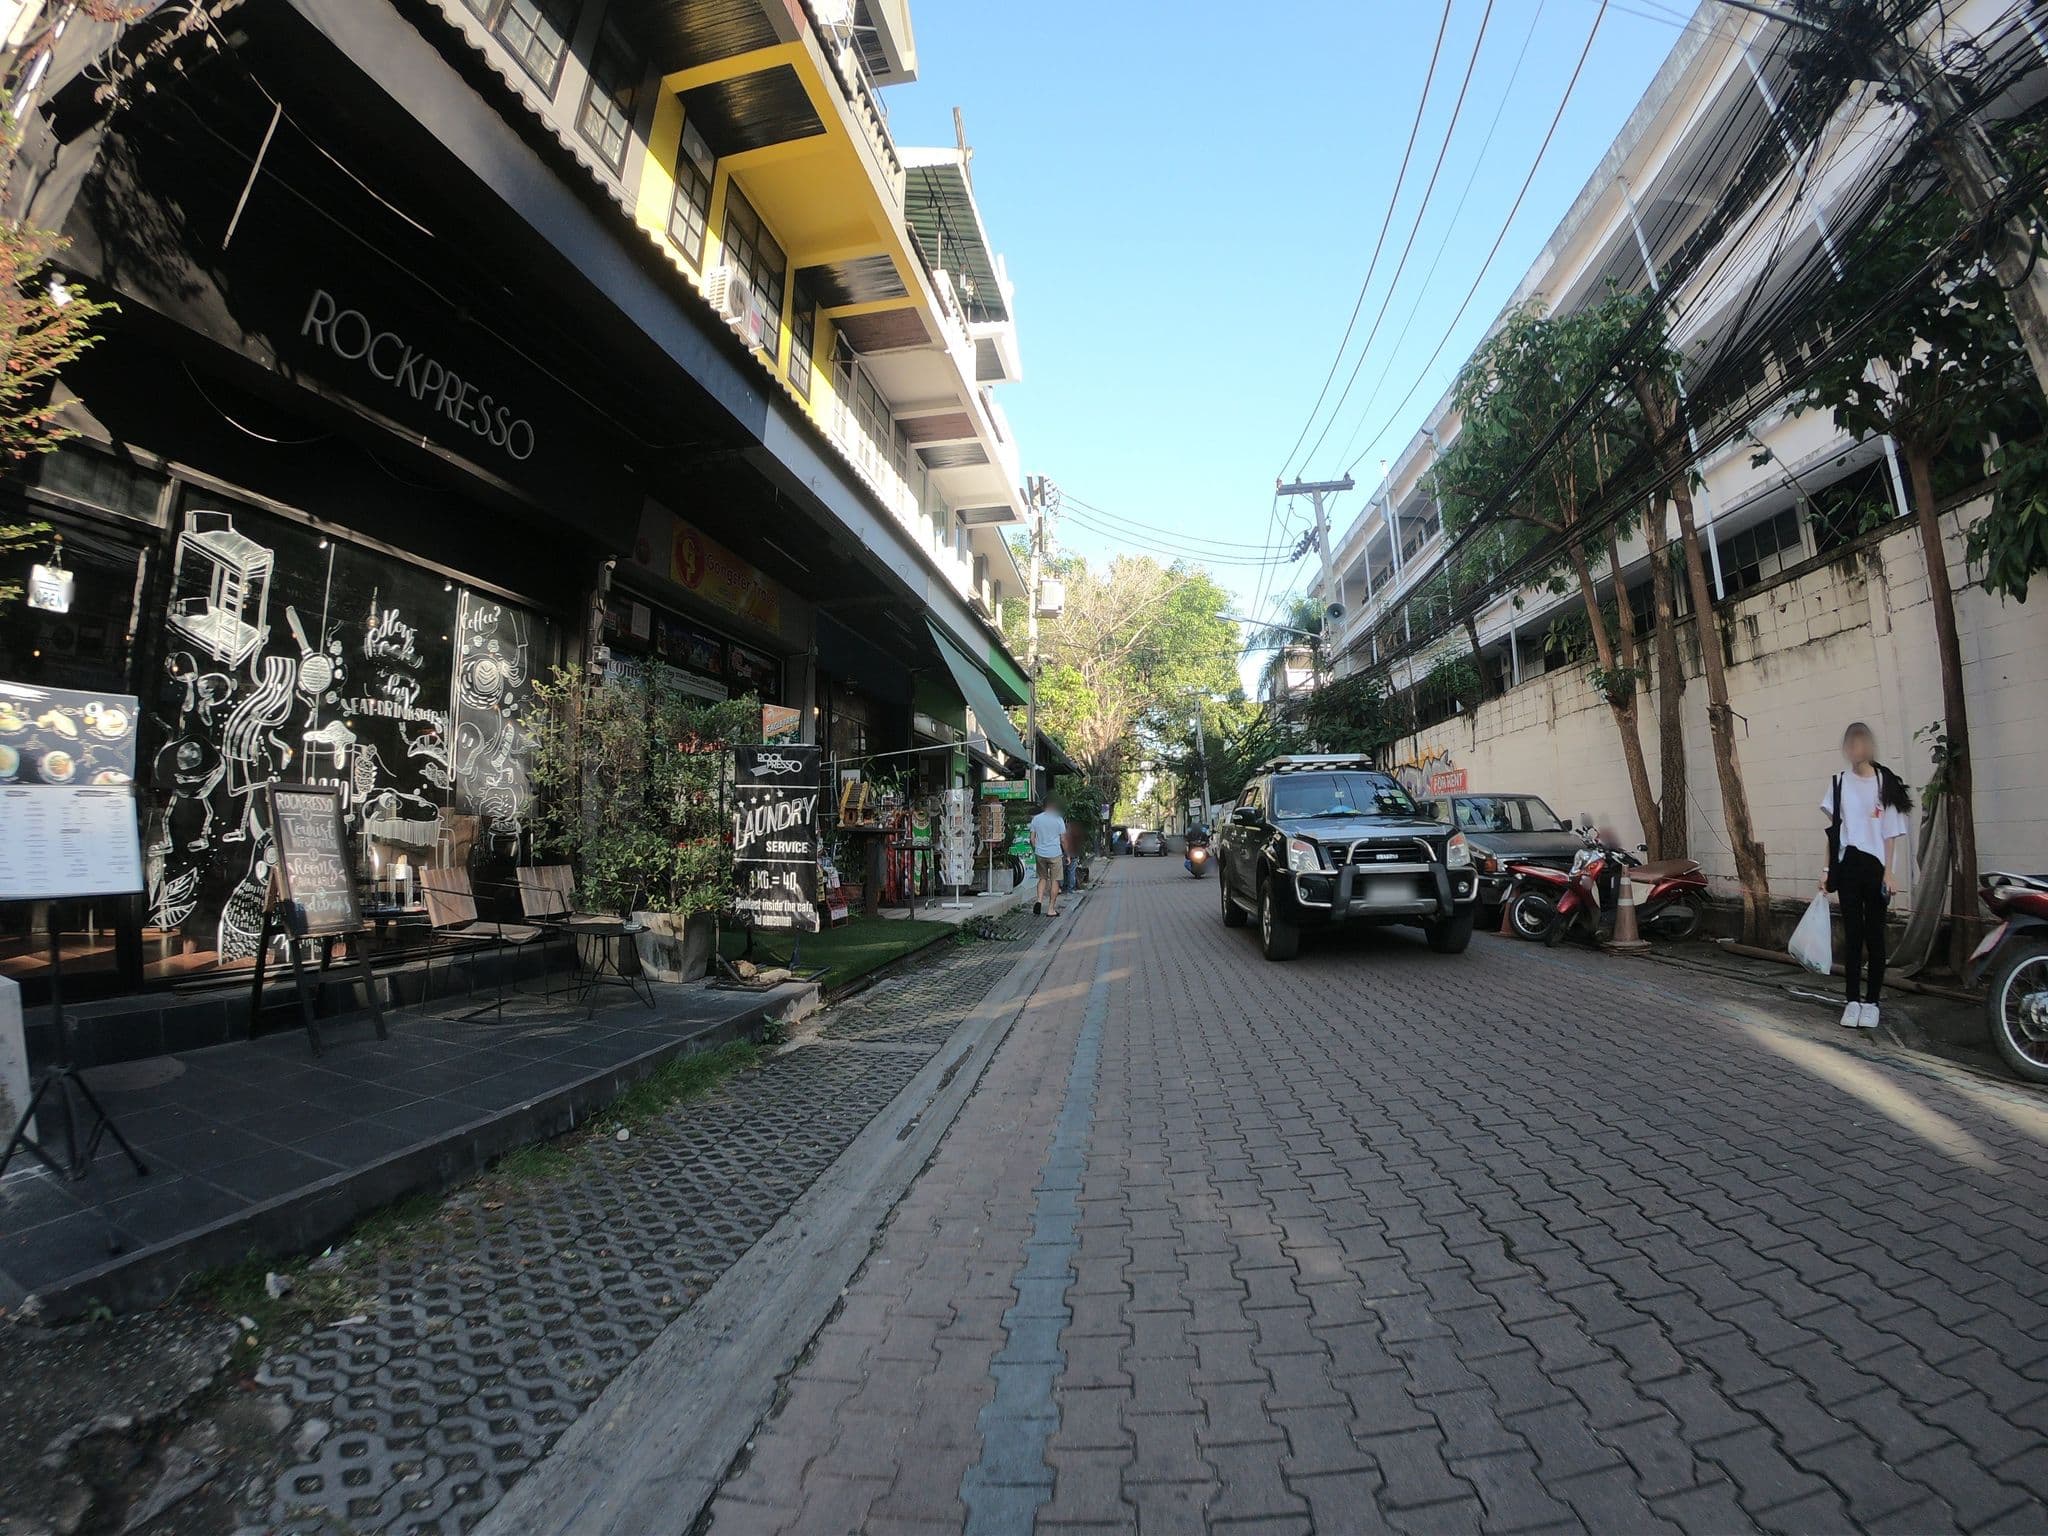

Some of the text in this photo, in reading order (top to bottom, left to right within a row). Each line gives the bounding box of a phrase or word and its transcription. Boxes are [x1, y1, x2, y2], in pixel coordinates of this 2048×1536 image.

[301, 288, 535, 460] ROCKPRESSO
[757, 753, 781, 762] ROCK
[767, 760, 802, 773] PRESSO
[275, 793, 334, 813] ROCKPRESSO
[734, 794, 817, 850] LAUNDRY
[766, 840, 808, 853] SERVICE
[762, 898, 783, 912] inside
[784, 899, 796, 912] the
